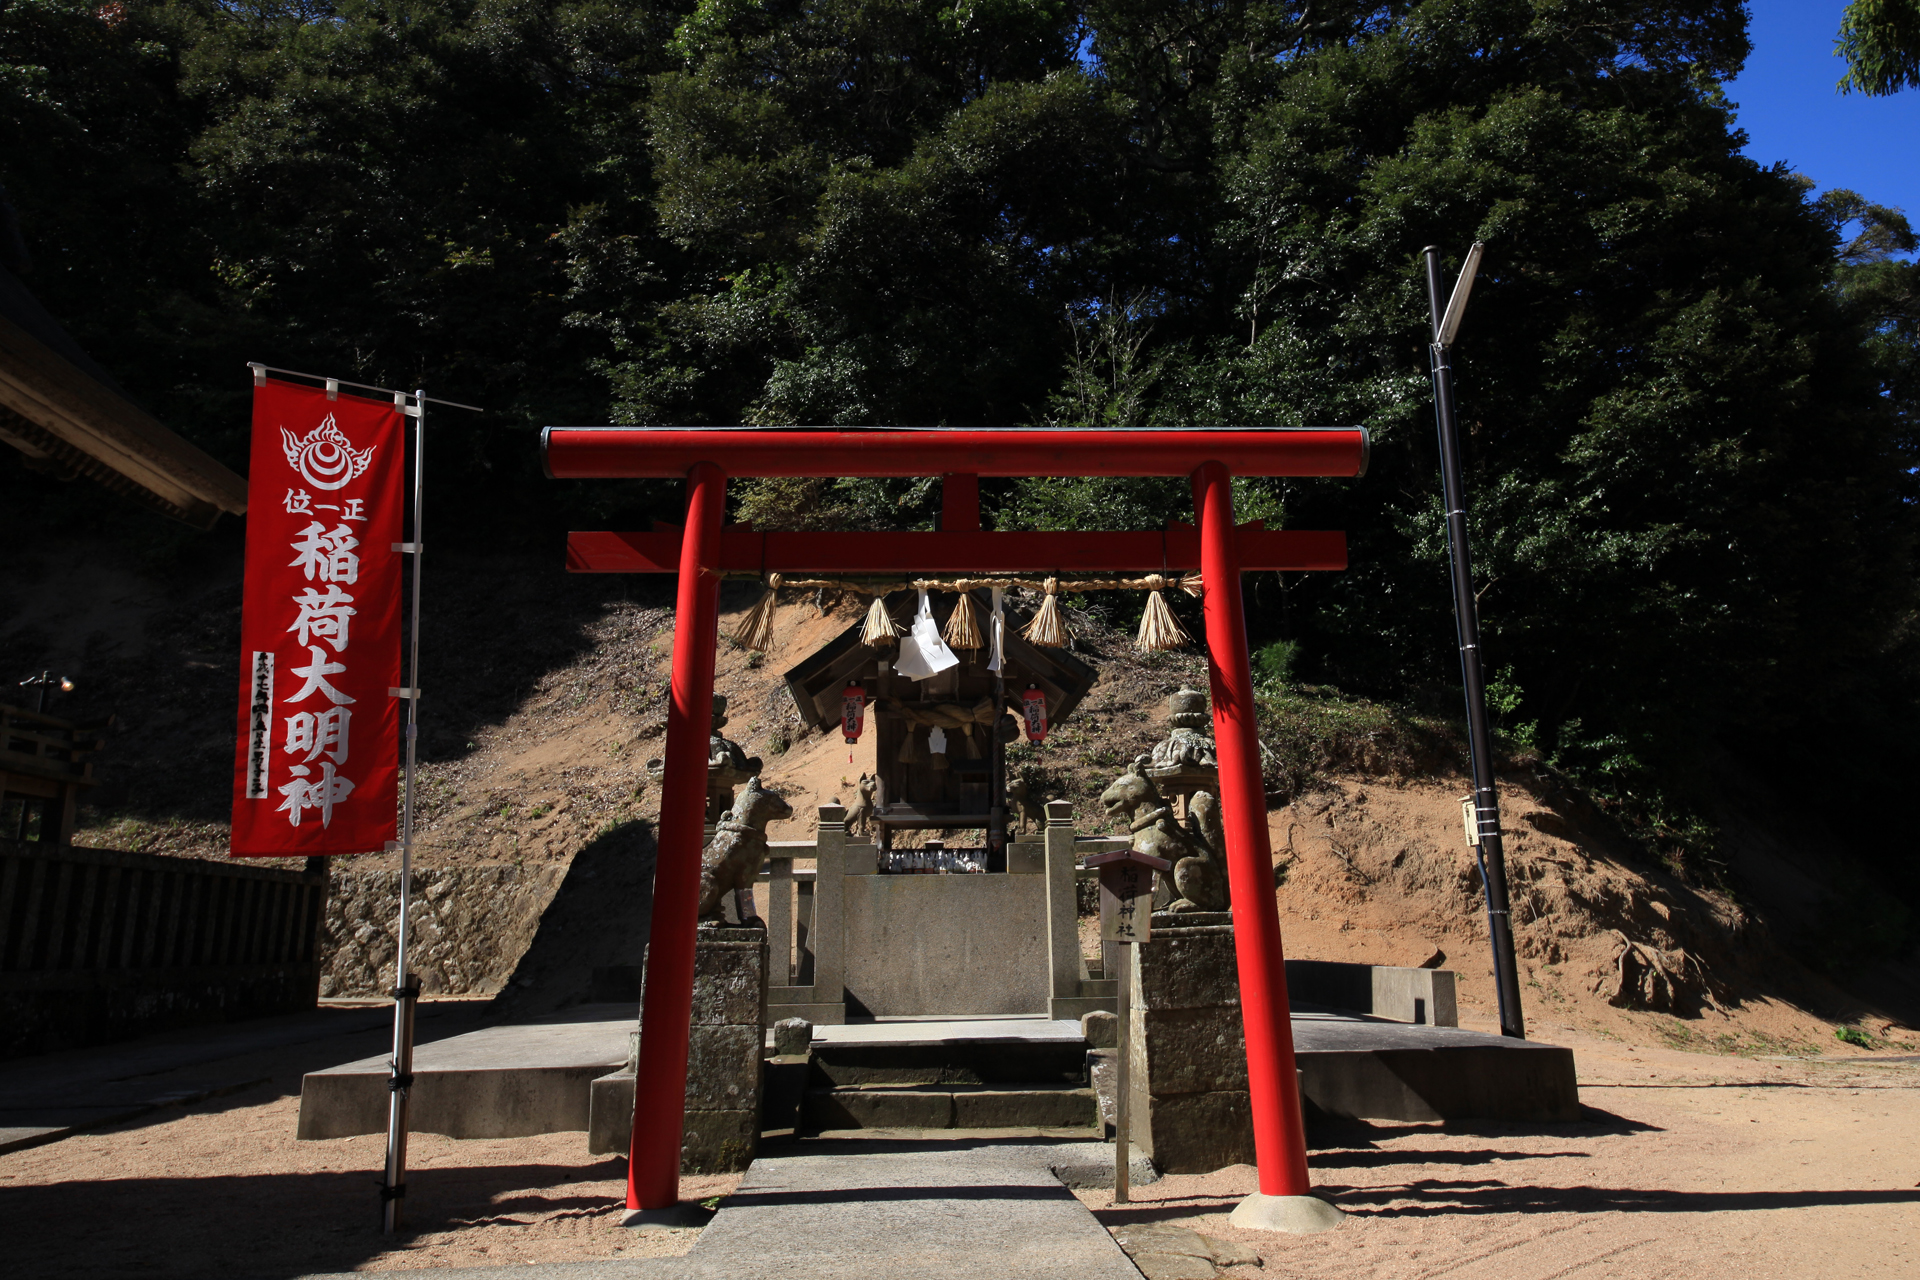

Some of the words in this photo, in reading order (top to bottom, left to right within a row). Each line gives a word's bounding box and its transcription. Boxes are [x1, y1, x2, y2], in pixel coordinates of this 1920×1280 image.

[274, 521, 360, 829] 稲荷大明神
[1115, 865, 1139, 938] 稲荷神社
